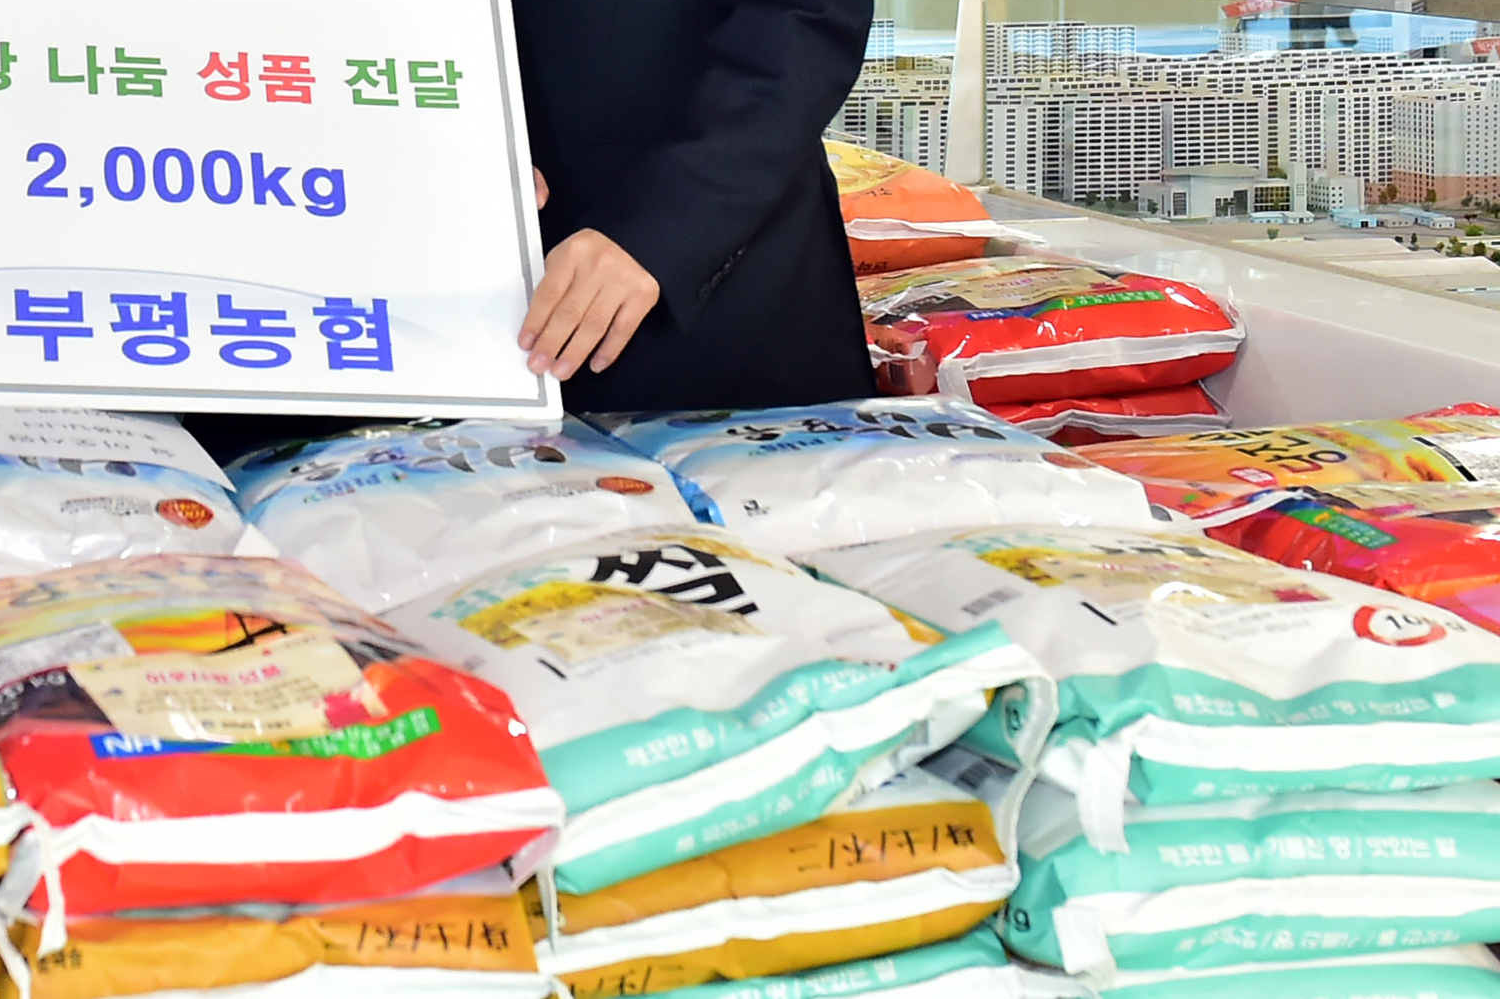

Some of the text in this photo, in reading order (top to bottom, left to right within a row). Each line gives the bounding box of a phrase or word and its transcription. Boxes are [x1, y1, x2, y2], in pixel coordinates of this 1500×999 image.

[46, 44, 165, 99] 나눔
[196, 48, 319, 105] 성품
[344, 55, 465, 109] 전달
[24, 143, 349, 218] 2,000kg
